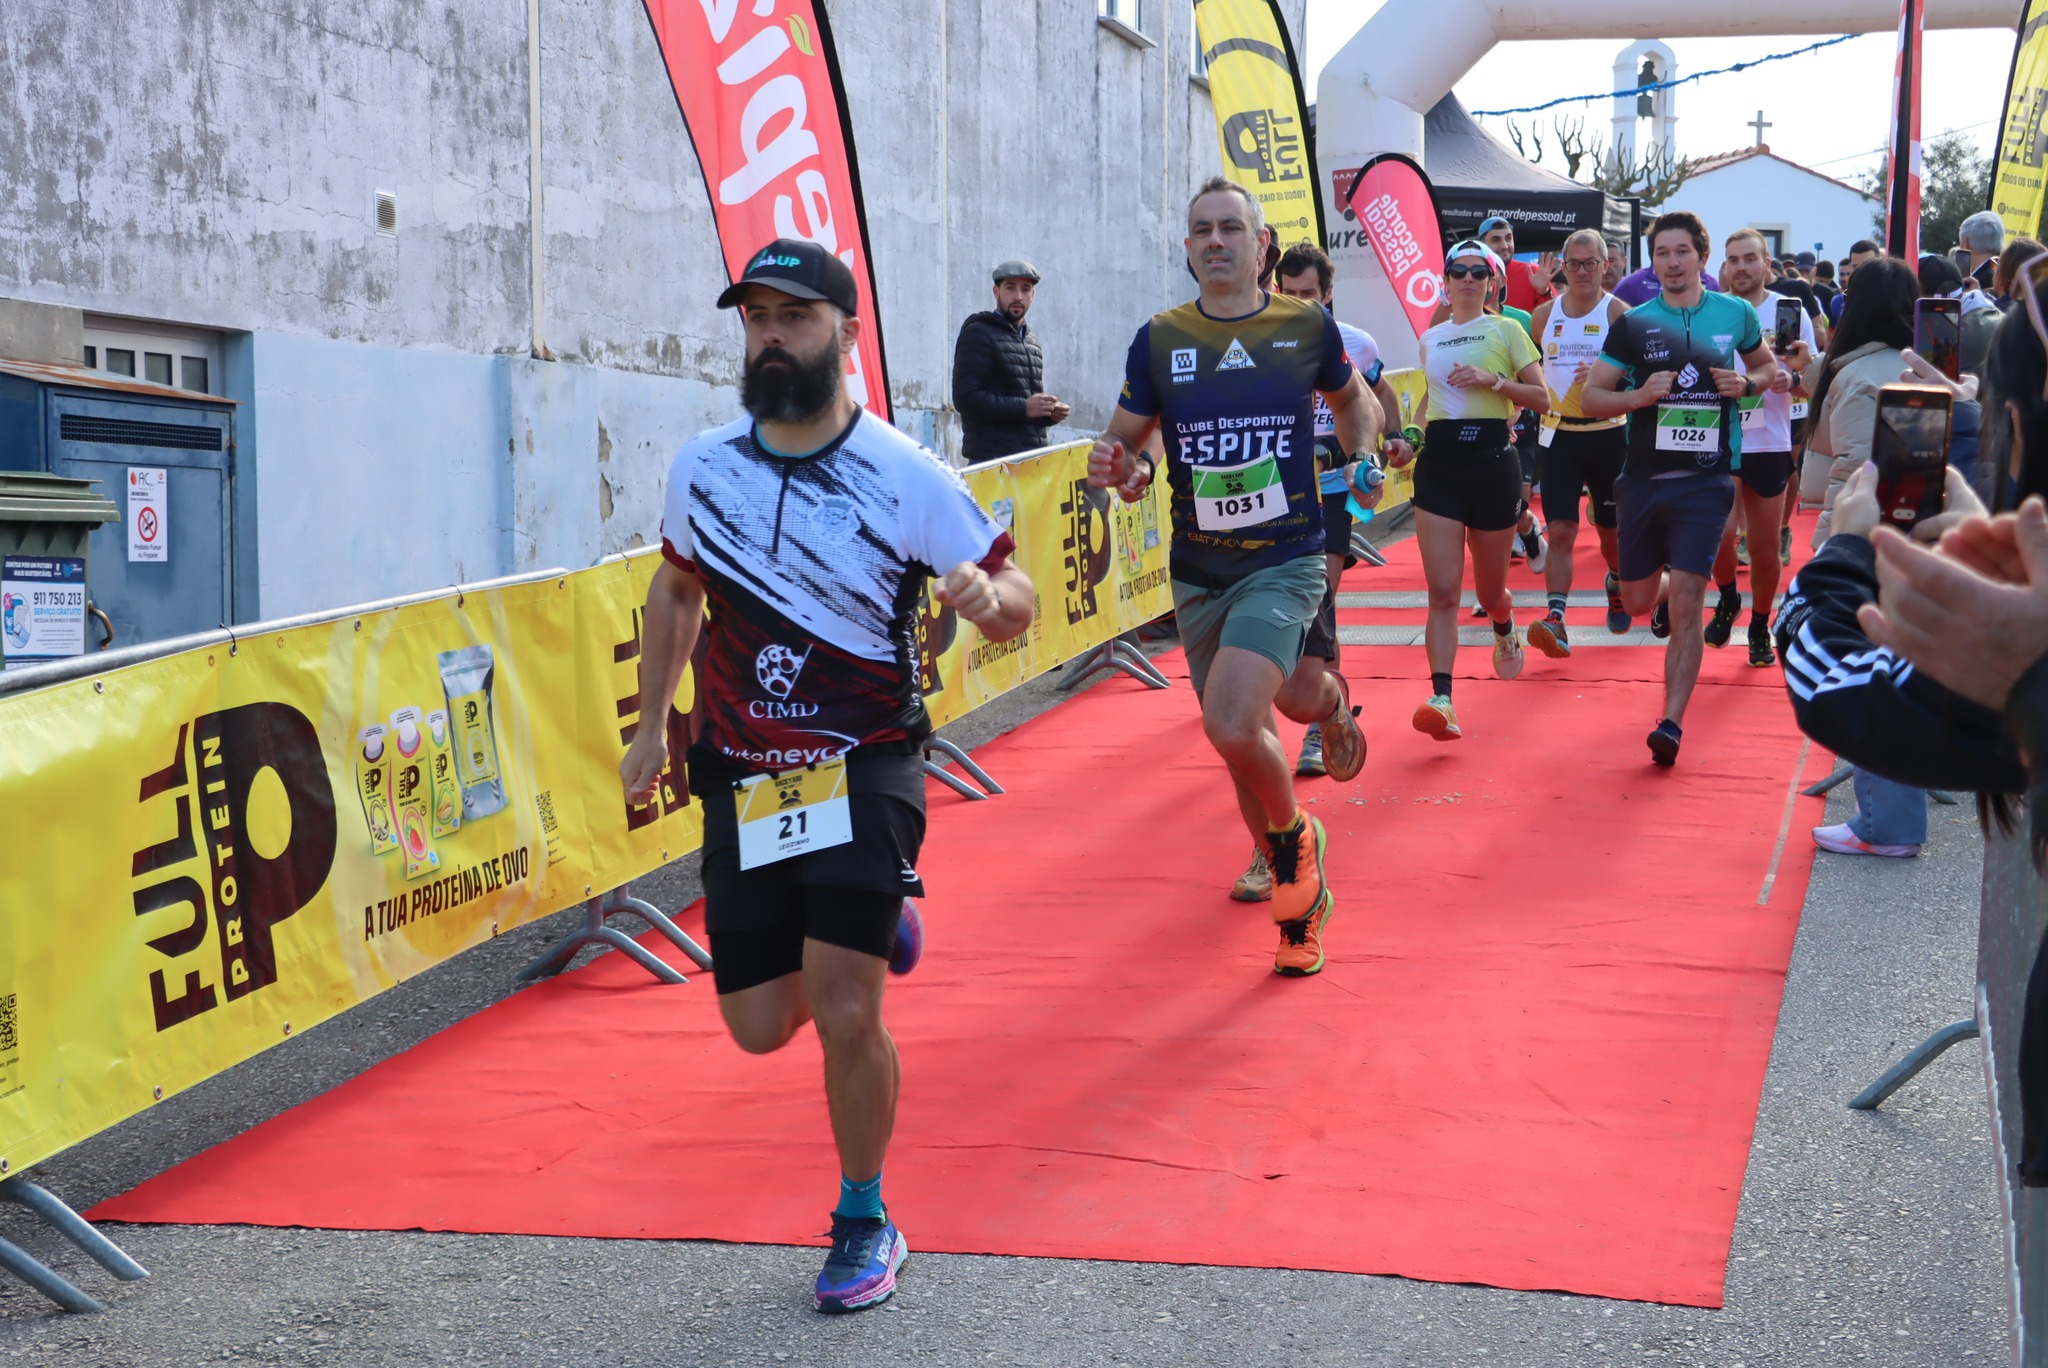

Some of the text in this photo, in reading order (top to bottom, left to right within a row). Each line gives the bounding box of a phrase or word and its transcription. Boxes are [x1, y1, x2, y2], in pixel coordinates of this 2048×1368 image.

[1441, 208, 1472, 218] resultados
[1487, 208, 1577, 225] recordepessoal.pt
[1643, 350, 1670, 360] LASBF
[1172, 375, 1195, 383] MAJOR
[1176, 415, 1296, 434] CLUBE DESPORTIVO
[1671, 429, 1706, 441] 1026
[1178, 429, 1293, 464] ESPITE
[1214, 492, 1265, 517] 1031
[1060, 481, 1082, 625] FULL
[1077, 490, 1091, 612] PROTEIN
[33, 592, 82, 606] 911 750 213
[749, 700, 819, 719] CIMD
[778, 810, 807, 840] 21
[778, 837, 811, 851] LEOZINHO
[202, 736, 250, 986] PROTEIN
[131, 722, 218, 1032] FULL
[365, 906, 375, 941] A
[377, 893, 407, 936] TUA
[410, 864, 483, 922] PROTEÍNA
[482, 857, 502, 894] DE
[502, 846, 528, 885] OVO
[875, 1231, 893, 1268] HOKA
